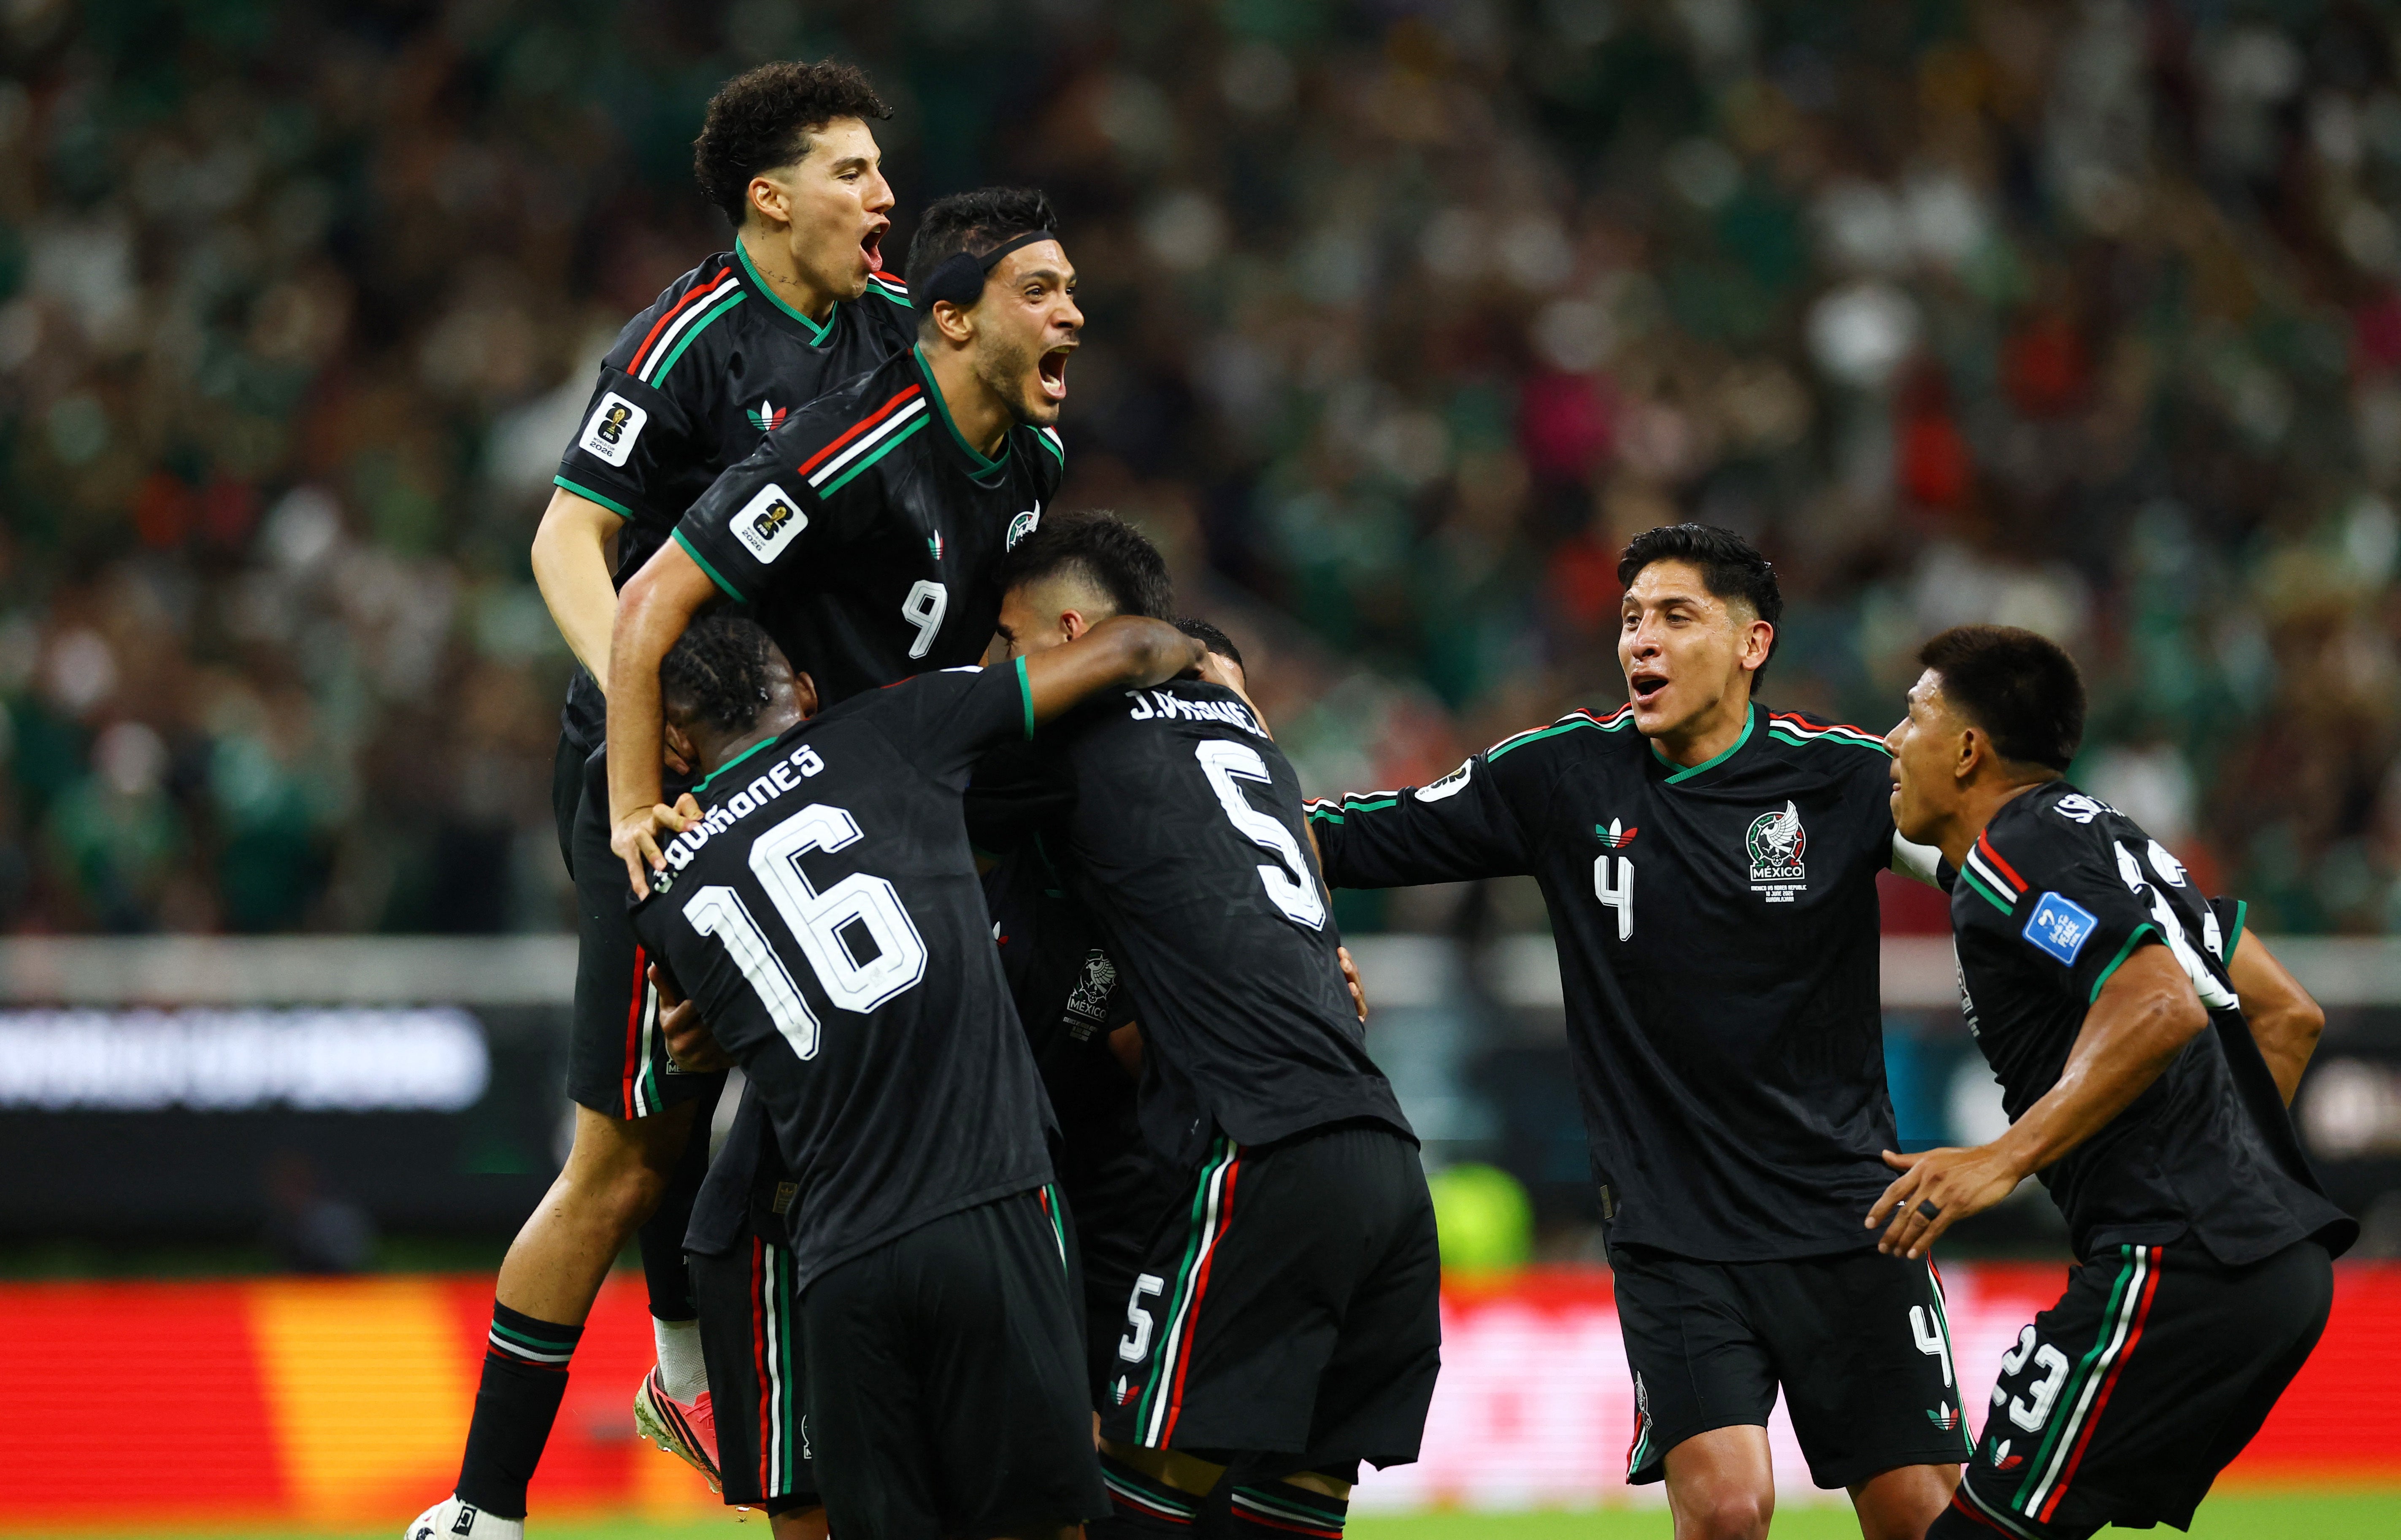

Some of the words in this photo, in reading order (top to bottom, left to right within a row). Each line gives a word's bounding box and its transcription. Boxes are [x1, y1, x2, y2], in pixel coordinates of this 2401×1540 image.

[589, 441, 613, 457] 2026
[593, 437, 608, 447] WORLD
[603, 431, 614, 441] FIFA
[742, 530, 762, 551] 2026
[757, 523, 768, 536] FIFA
[902, 580, 948, 659] 9
[1195, 740, 1327, 932] 5
[1753, 865, 1802, 878] MÉXICO
[1594, 855, 1635, 941] 4
[682, 803, 928, 1061] 16
[1071, 998, 1106, 1019] MÉXICO
[1119, 1273, 1164, 1363] 5
[1909, 1303, 1952, 1388] 4
[1991, 1324, 2069, 1433] 23
